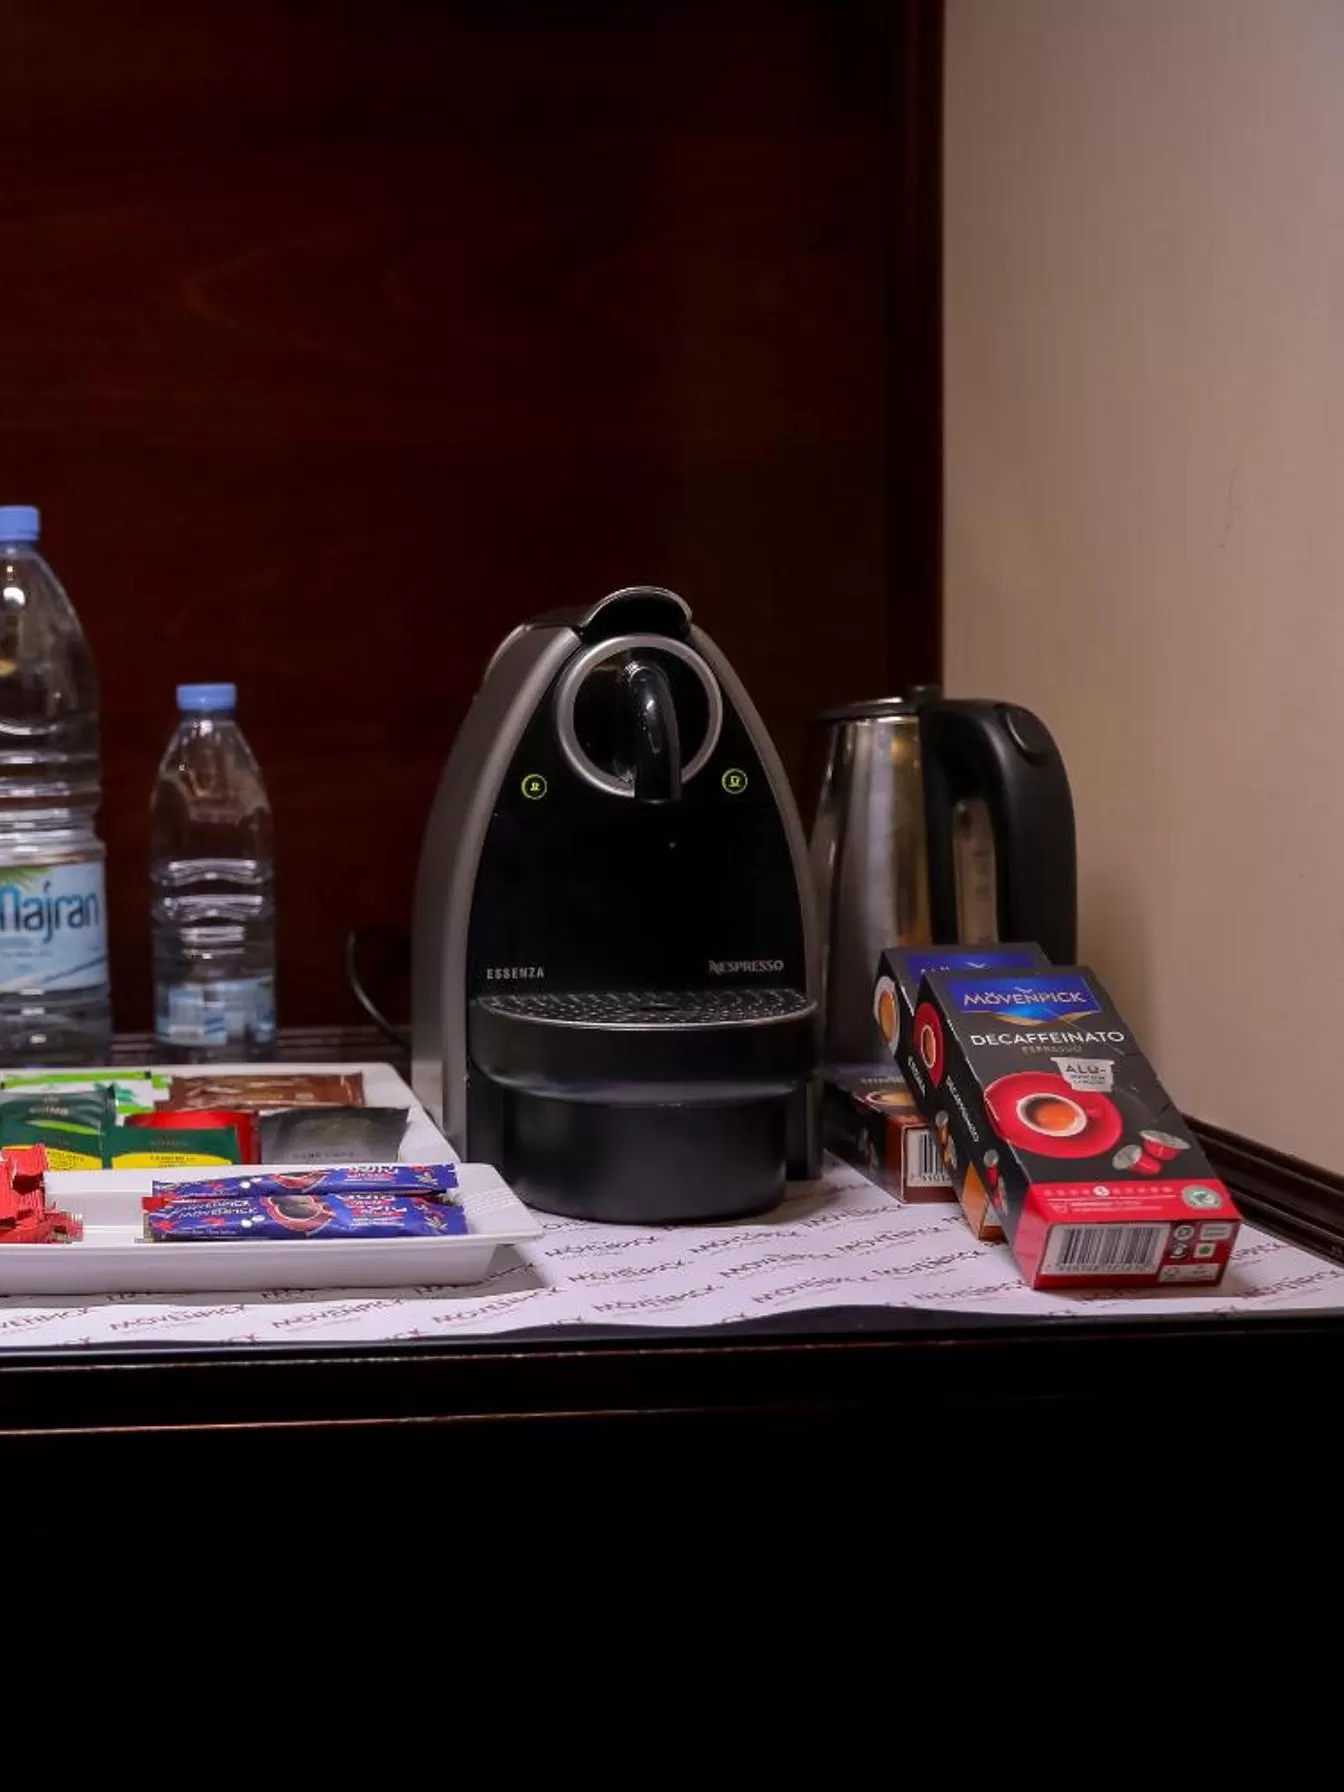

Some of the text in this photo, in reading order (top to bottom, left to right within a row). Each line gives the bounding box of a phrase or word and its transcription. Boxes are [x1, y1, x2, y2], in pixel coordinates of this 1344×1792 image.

[487, 967, 545, 980] ESSENZA
[708, 959, 784, 976] NESPRESSO
[970, 1031, 1125, 1046] DECAFFEINATO
